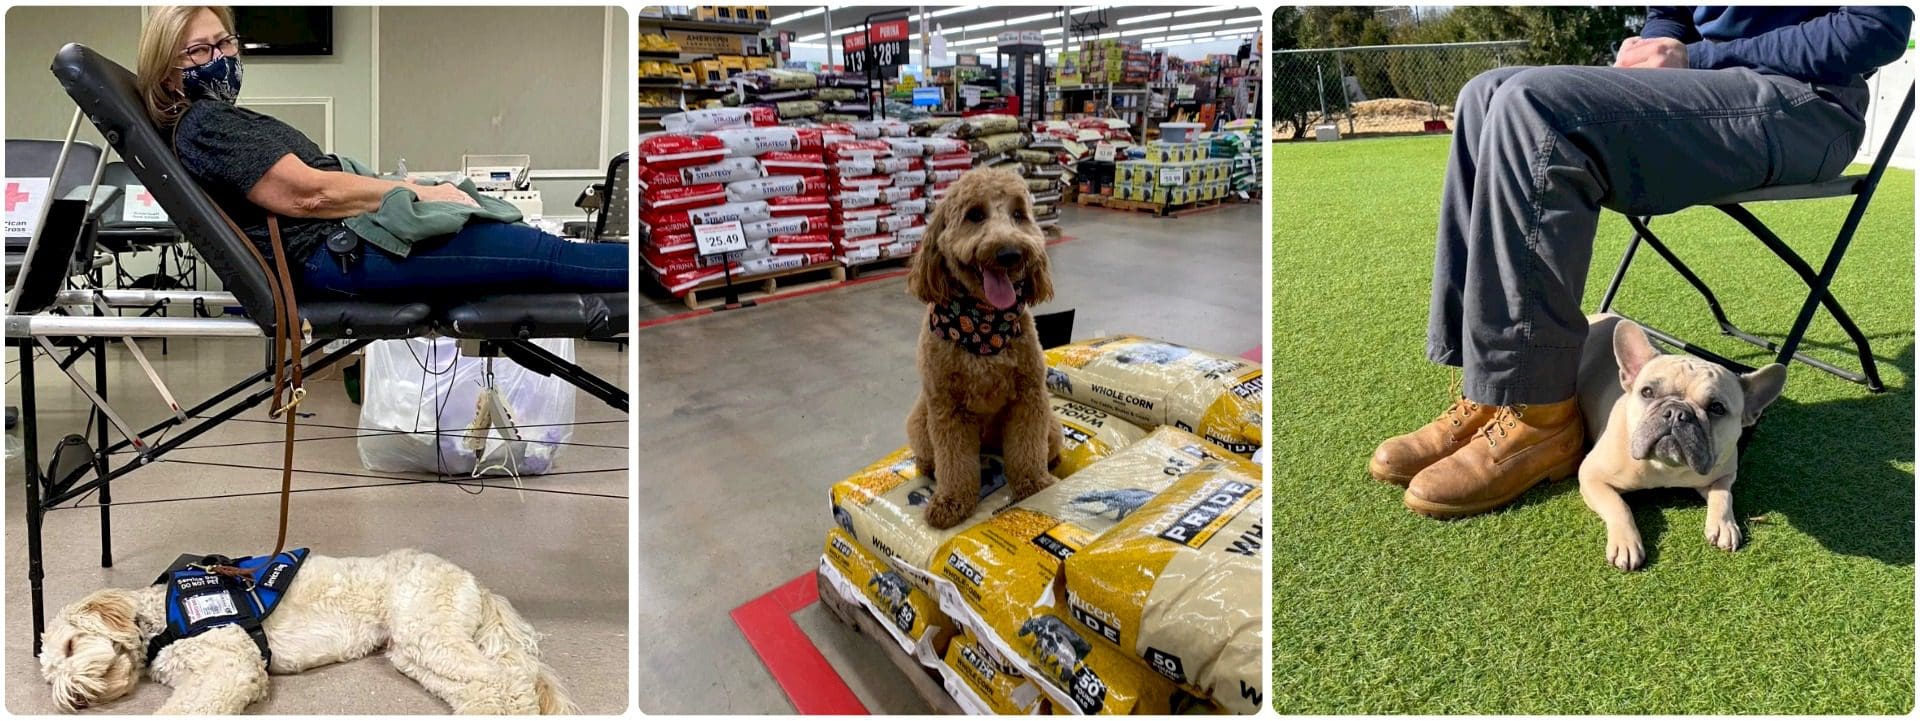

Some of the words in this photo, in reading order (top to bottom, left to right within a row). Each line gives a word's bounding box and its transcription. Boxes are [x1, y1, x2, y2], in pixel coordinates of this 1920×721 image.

[880, 24, 900, 38] PURINA
[755, 140, 788, 150] STRATEGY
[696, 169, 732, 181] STRATEGY
[762, 185, 794, 194] STRATEGY
[768, 224, 798, 234] STRATEGY
[705, 233, 739, 247] $25.49
[768, 260, 799, 270] STRATEGY
[1091, 383, 1124, 401] WHOLE
[1125, 394, 1154, 411] CORN
[1064, 402, 1107, 420] CORN
[1164, 480, 1250, 541] PRIDE
[949, 553, 983, 585] PRIDE
[180, 582, 192, 590] DO
[263, 571, 281, 587] Service
[943, 566, 966, 586] WHOLE
[965, 583, 982, 601] CORN
[962, 646, 994, 680] PRIDE
[1153, 651, 1177, 672] 50
[957, 656, 977, 679] WHOLE
[976, 676, 993, 696] CORN
[1079, 673, 1099, 697] 50
[1073, 684, 1095, 706] POUND
